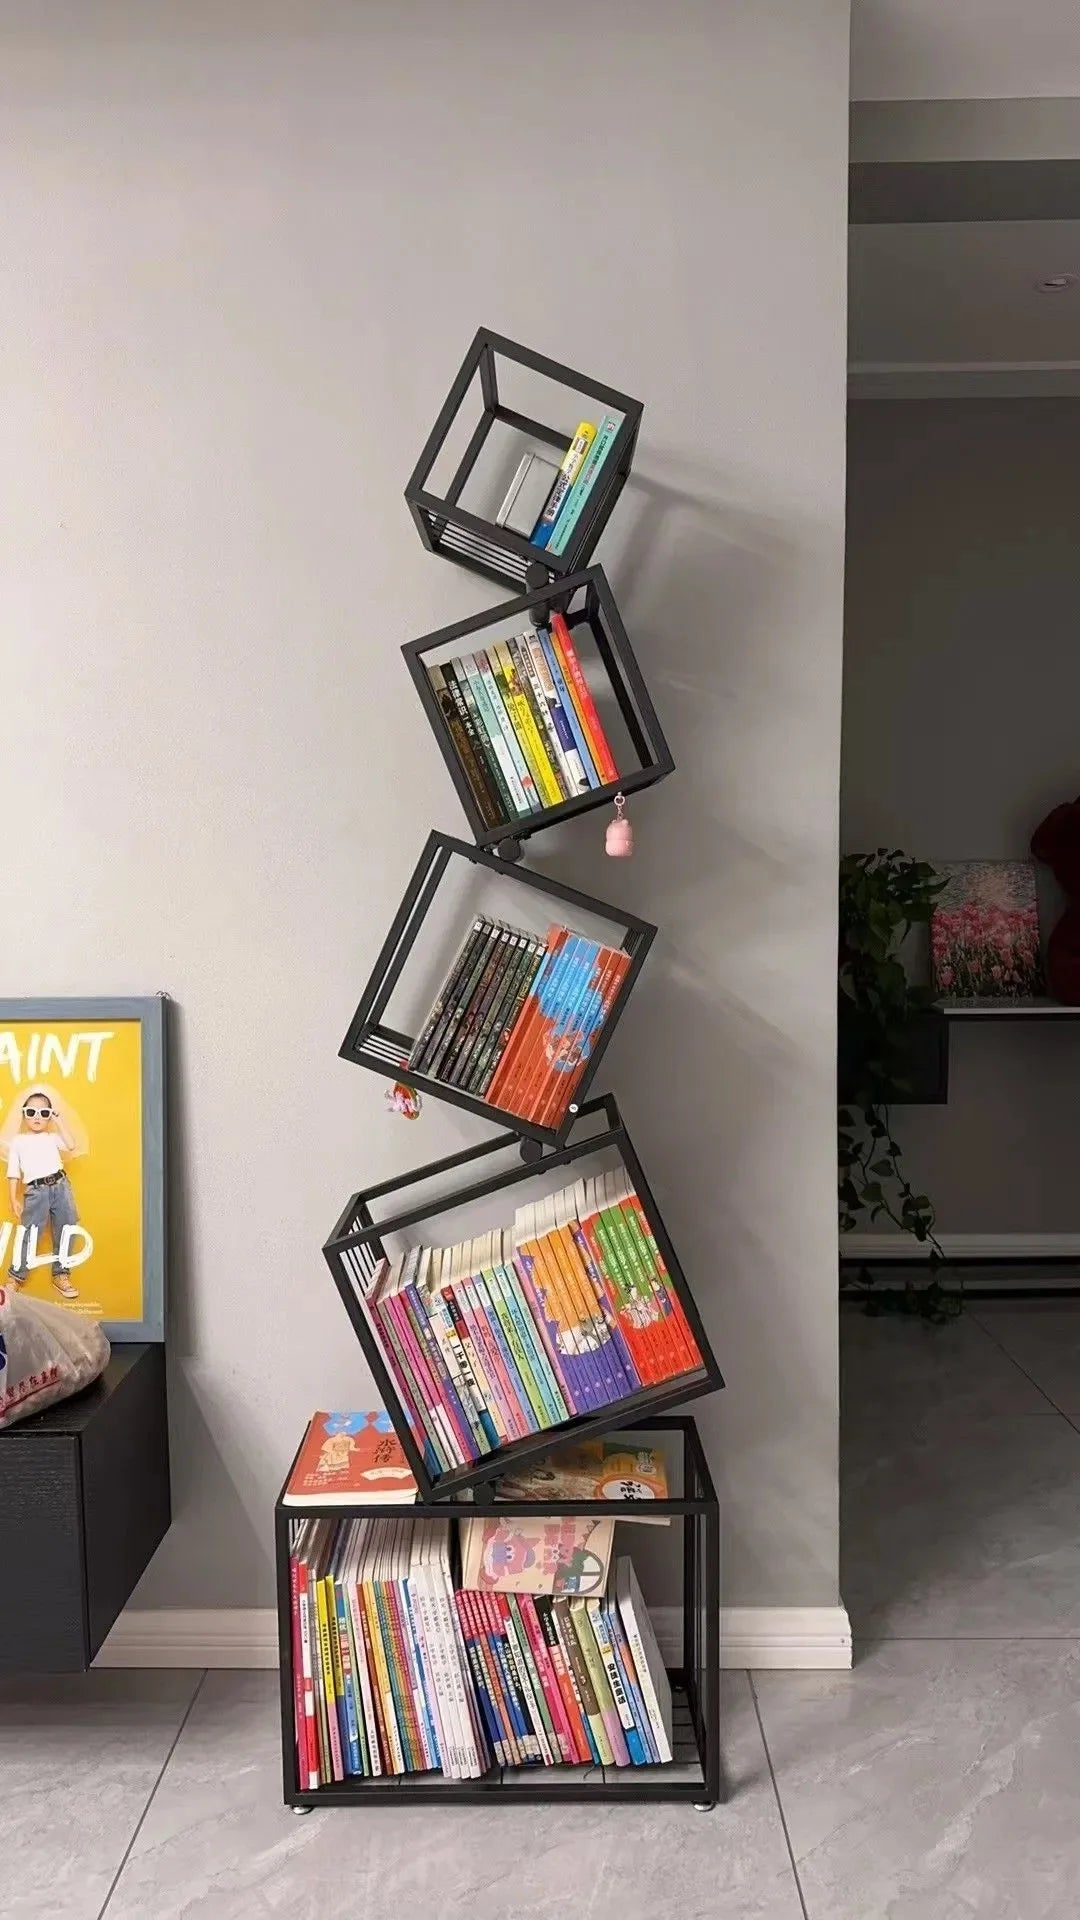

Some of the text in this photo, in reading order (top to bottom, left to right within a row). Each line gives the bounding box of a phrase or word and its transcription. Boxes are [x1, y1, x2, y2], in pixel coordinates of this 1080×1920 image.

[448, 680, 475, 737] 法律常识一本全
[373, 1438, 397, 1463] 水浒传
[606, 1662, 626, 1705] 安徒生童话
